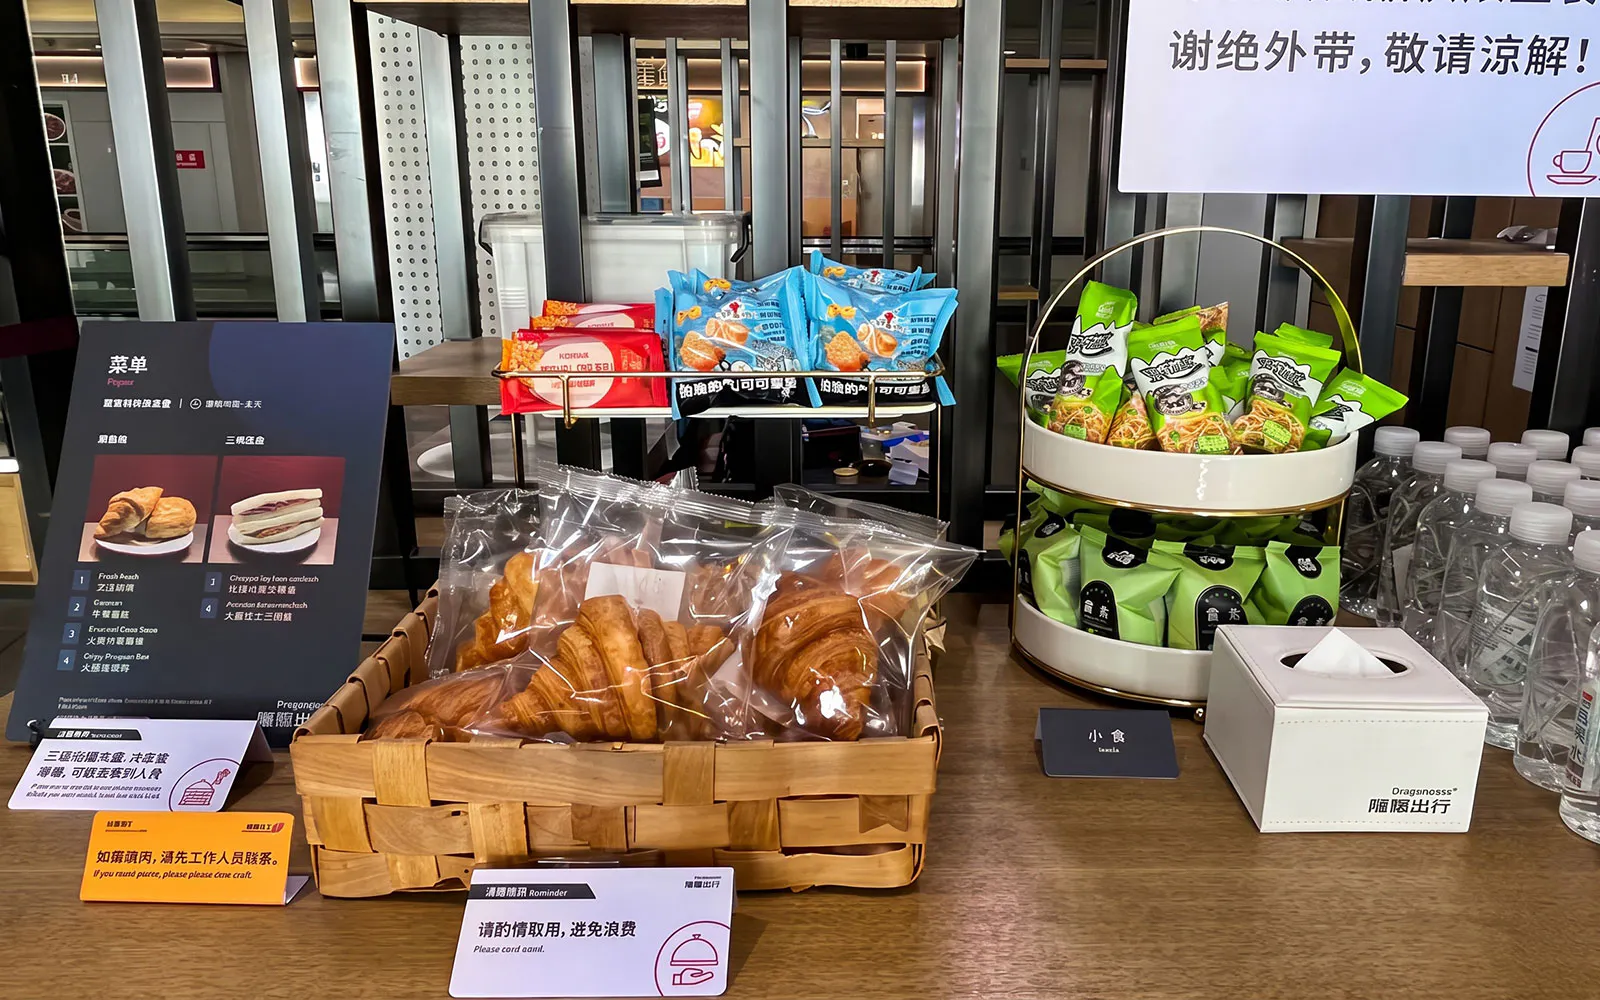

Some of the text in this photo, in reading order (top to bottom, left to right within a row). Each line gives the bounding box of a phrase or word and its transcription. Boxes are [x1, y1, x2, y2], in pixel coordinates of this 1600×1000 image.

[108, 355, 148, 374] 菜单
[73, 603, 80, 611] 2
[68, 629, 75, 638] 3
[63, 656, 69, 665] 4
[100, 871, 114, 879] you
[162, 870, 188, 879] please
[188, 870, 214, 879] please
[529, 888, 568, 897] Rominder
[473, 945, 501, 953] Please
